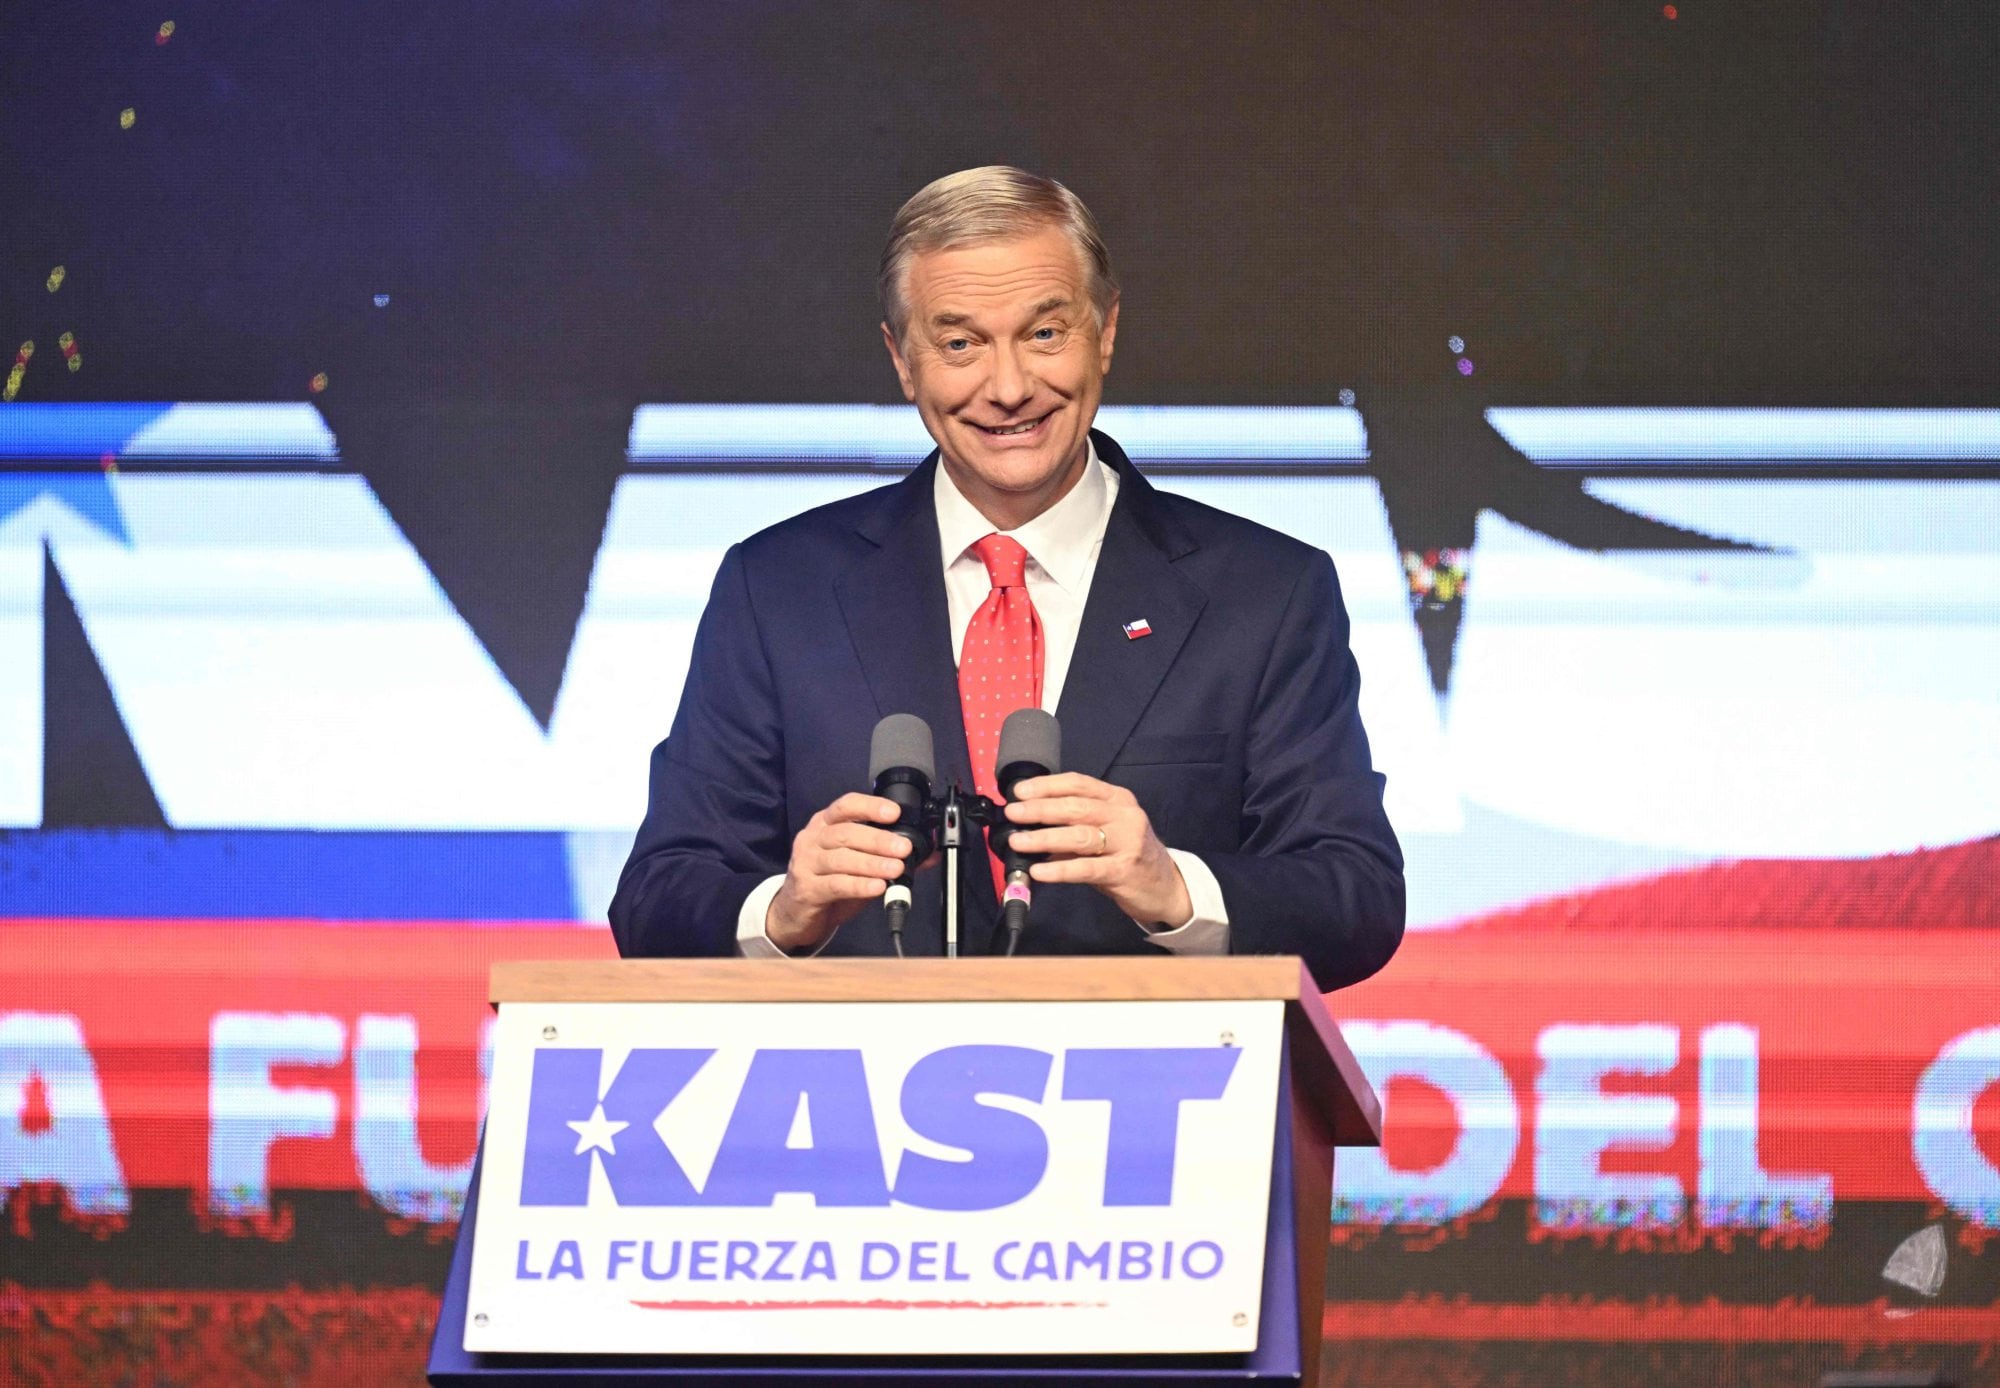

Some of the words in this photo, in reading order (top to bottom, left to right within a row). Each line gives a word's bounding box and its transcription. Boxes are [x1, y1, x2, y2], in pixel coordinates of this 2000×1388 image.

[519, 1043, 1244, 1213] KAST
[1330, 1020, 1832, 1226] DEL
[515, 1239, 584, 1281] LA
[606, 1240, 836, 1281] FUERZA
[860, 1241, 968, 1281] DEL
[992, 1241, 1225, 1281] CAMBIO
